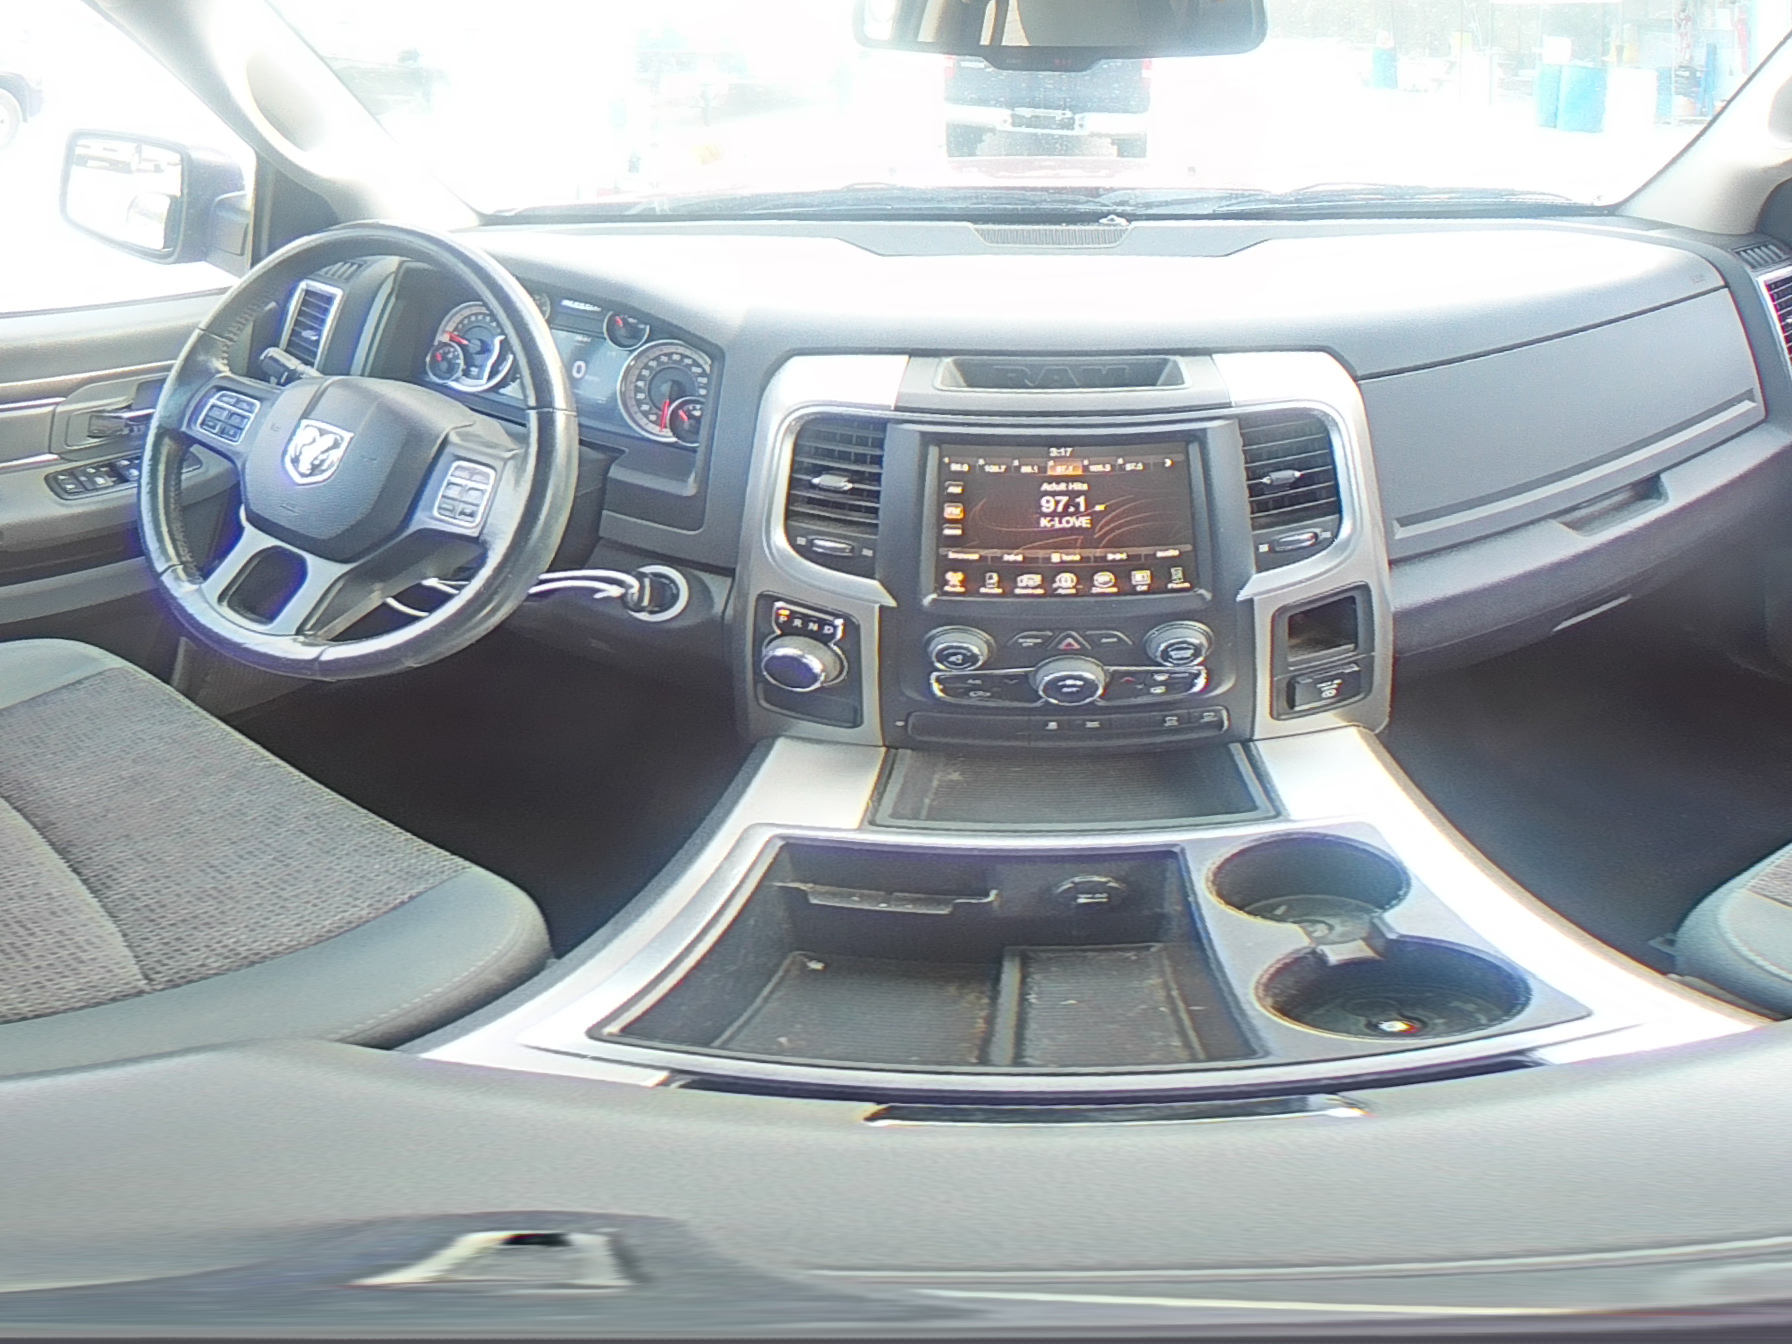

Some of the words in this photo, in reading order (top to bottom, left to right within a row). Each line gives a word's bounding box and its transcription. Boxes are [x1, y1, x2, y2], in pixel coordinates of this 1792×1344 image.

[572, 360, 587, 379] 0
[1049, 447, 1073, 457] 3:17
[1040, 495, 1086, 513] 97.1
[1040, 516, 1092, 528] K-LOVE
[792, 618, 804, 628] R
[808, 622, 819, 631] N
[823, 625, 834, 634] D
